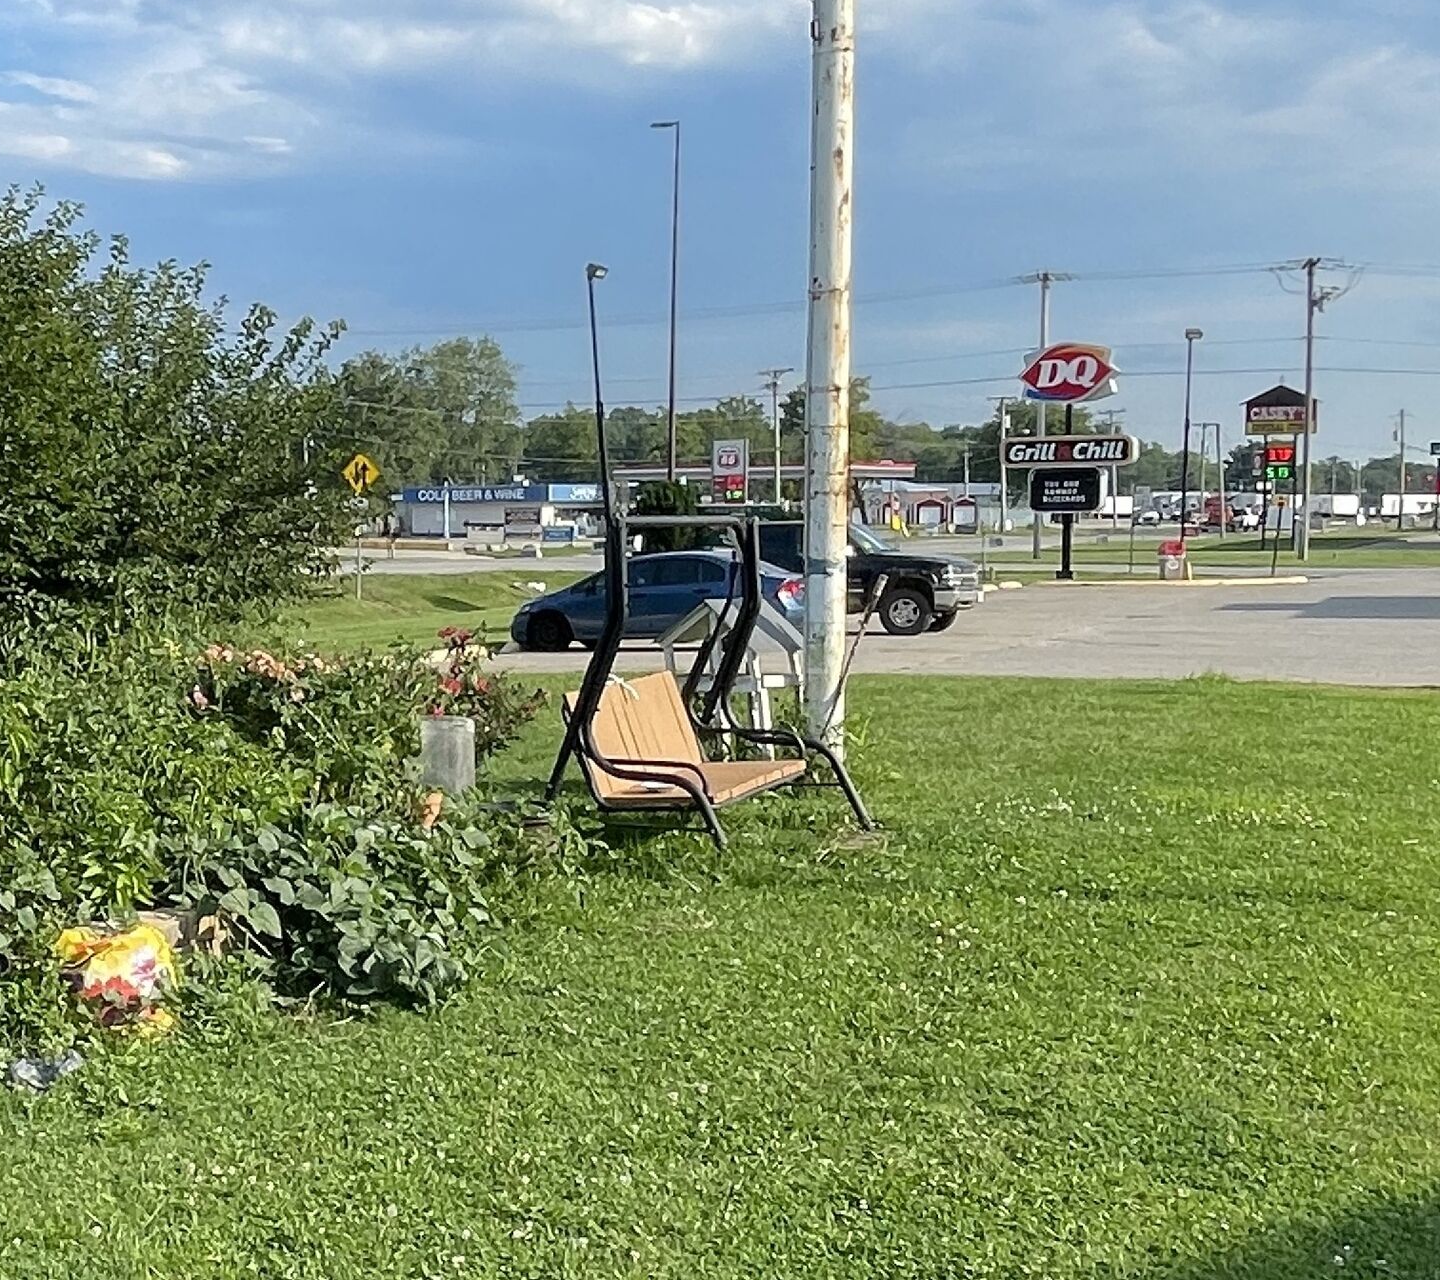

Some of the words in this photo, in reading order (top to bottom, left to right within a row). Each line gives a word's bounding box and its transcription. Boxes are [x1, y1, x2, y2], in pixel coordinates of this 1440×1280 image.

[1036, 355, 1099, 389] DQ
[1009, 443, 1057, 462] Grill
[1072, 440, 1124, 460] Chill
[451, 489, 482, 501] BEER
[484, 489, 493, 501] &
[494, 487, 525, 500] WINE
